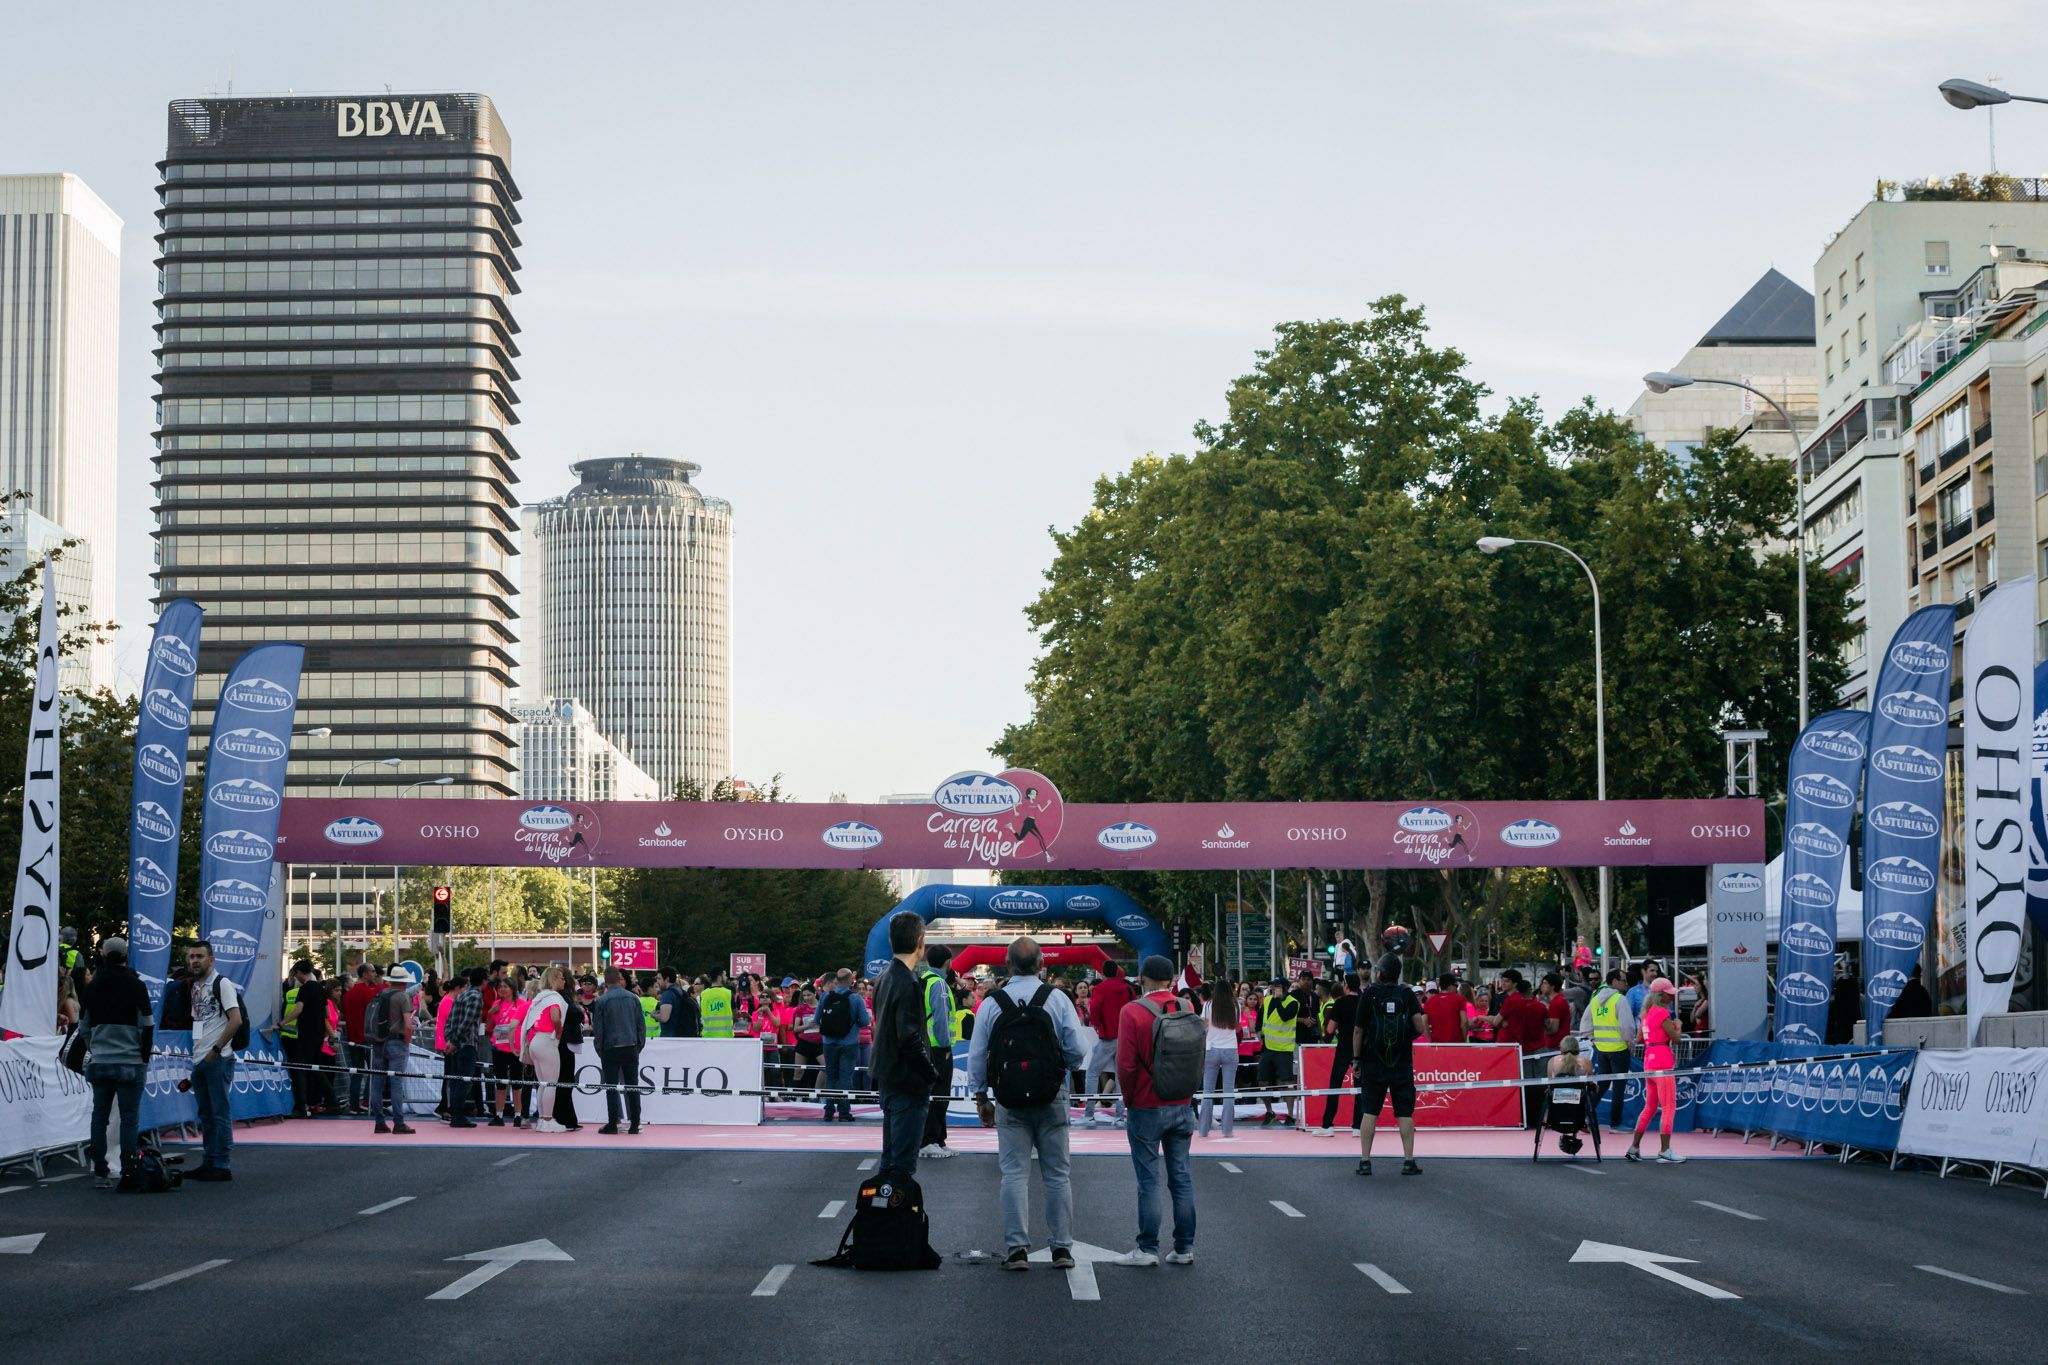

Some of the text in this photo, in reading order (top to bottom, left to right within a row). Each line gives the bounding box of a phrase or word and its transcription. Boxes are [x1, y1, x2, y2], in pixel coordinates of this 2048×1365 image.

[338, 101, 446, 137] BBVA
[229, 688, 288, 707] ASTURIANA
[1884, 699, 1940, 722] ASTURIANA
[220, 738, 280, 756] ASTURIANA
[1807, 735, 1858, 757] ASTURIANA
[1877, 754, 1938, 776] ASTURIANA
[215, 788, 275, 806] ASTURIANA
[941, 789, 1014, 804] ASTURIANA
[1795, 780, 1849, 805] ASTURIANA
[524, 814, 570, 825] ASTURIANA
[926, 812, 998, 833] Carrera
[1402, 816, 1449, 826] ASTURIANA
[1875, 811, 1934, 833] ASTURIANA
[1975, 665, 2025, 984] OYSHO
[329, 827, 379, 838] ASTURIANA
[420, 825, 479, 838] OYSHO
[514, 828, 559, 842] Carrera
[724, 827, 784, 841] OYSHO
[826, 831, 878, 844] ASTURIANA
[1102, 832, 1153, 844] ASTURIANA
[1287, 827, 1347, 841] OYSHO
[1393, 830, 1438, 844] Carrera
[1505, 830, 1556, 841] ASTURIANA
[1691, 824, 1750, 838] OYSHO
[638, 838, 686, 847] Santander
[1201, 840, 1250, 849] Santander
[1604, 836, 1651, 845] Santander
[1793, 832, 1837, 854] ASTURIANA
[211, 840, 268, 857] ASTURIANA
[525, 842, 534, 852] de
[540, 840, 575, 863] Mujer
[944, 831, 1024, 866] de la Mujer
[1404, 842, 1455, 865] de la Mujer
[1721, 880, 1760, 889] ASTURIANA
[1873, 867, 1929, 888] ASTURIANA
[208, 889, 262, 908] ASTURIANA
[994, 898, 1044, 910] ASTURIANA
[1717, 911, 1764, 922] OYSHO
[1786, 931, 1829, 951] ASTURIANA
[1872, 927, 1921, 943] ASTURIANA
[614, 939, 636, 949] SUB
[736, 956, 751, 964] SUB
[1291, 960, 1307, 968] SUB
[710, 1000, 724, 1012] Life
[574, 1065, 728, 1097] OSHO
[1921, 1071, 1970, 1111] OYSHO
[1985, 1071, 2037, 1114] OYSHO
